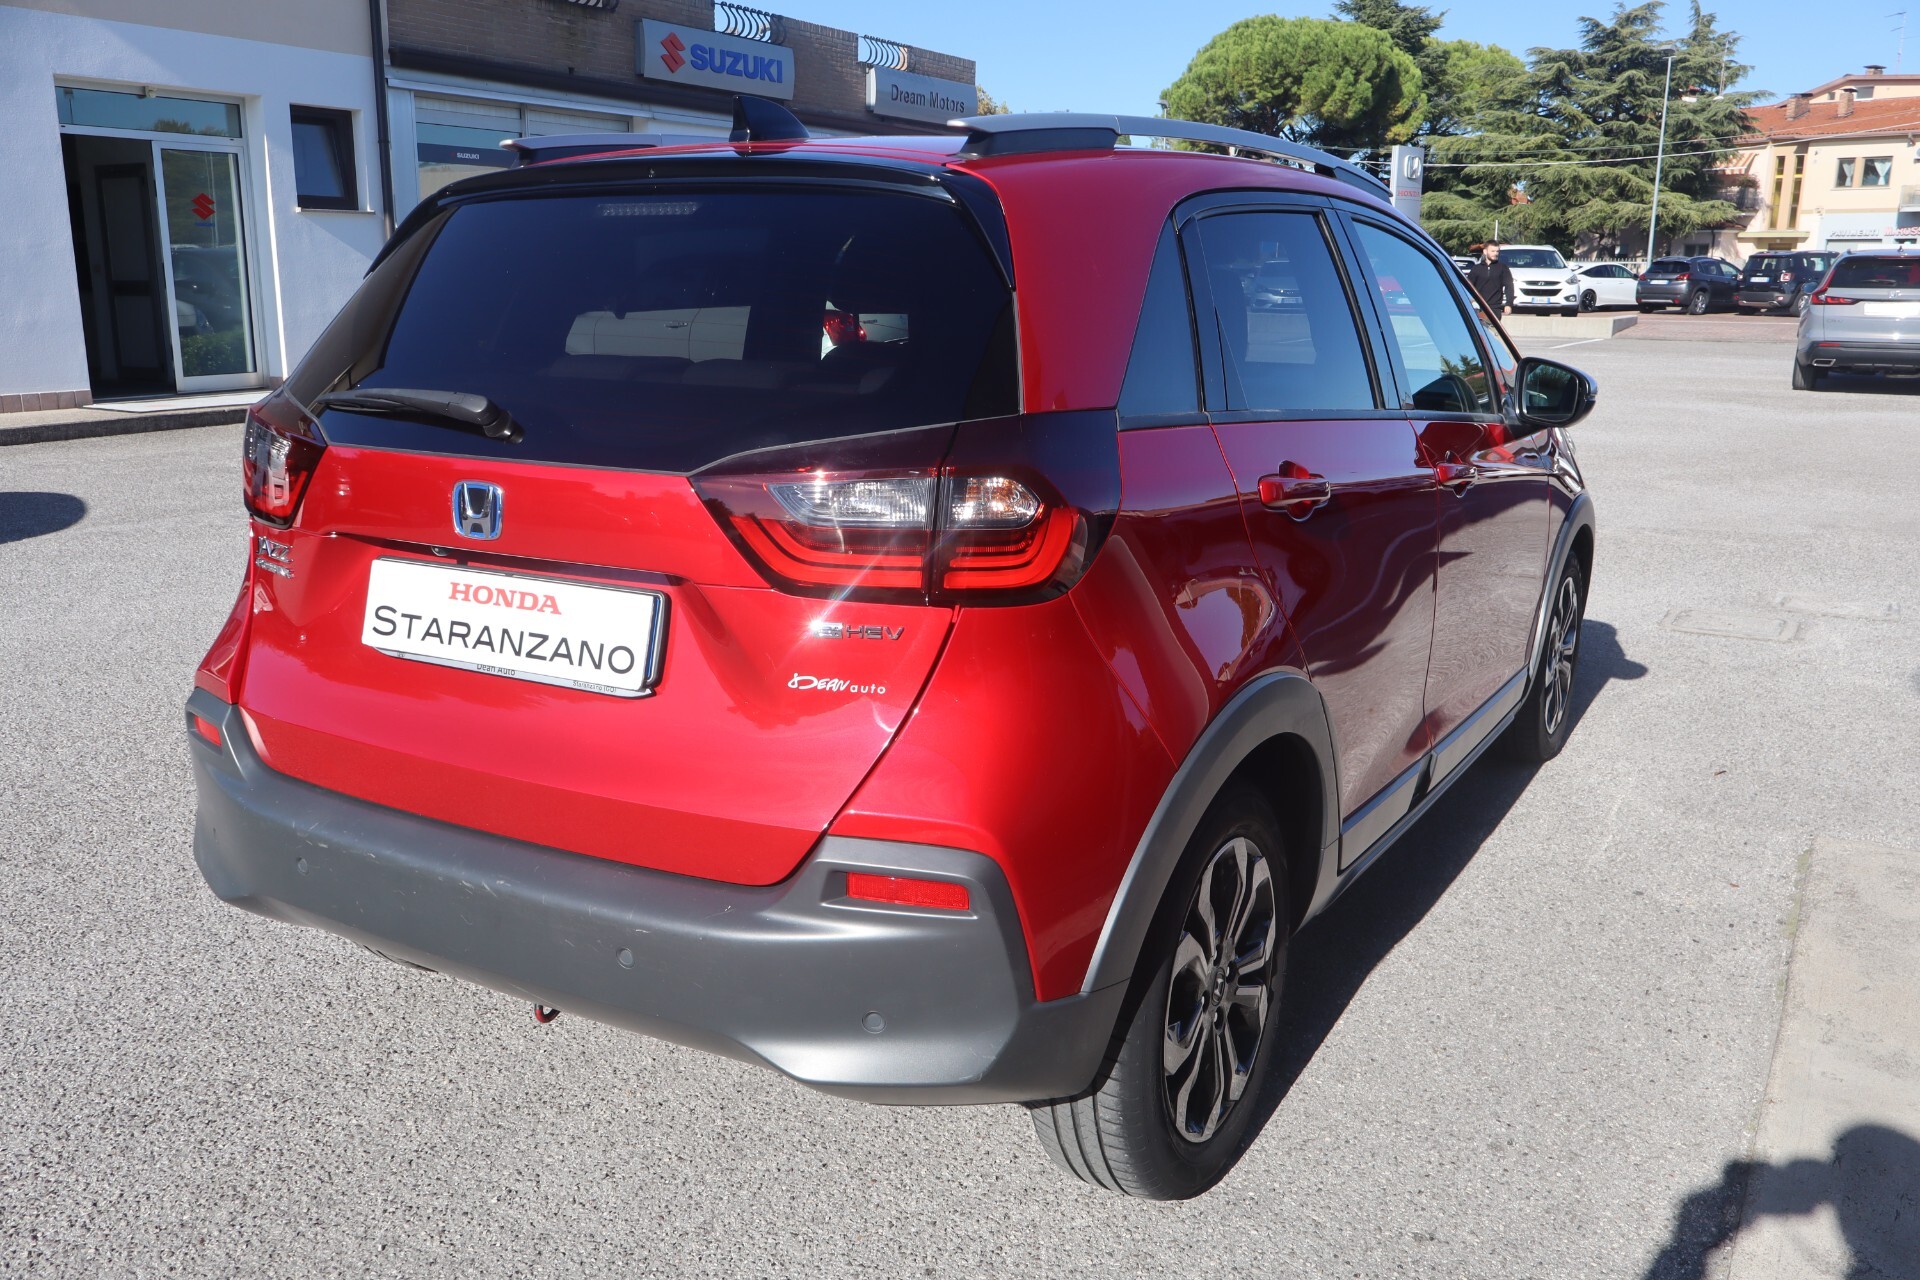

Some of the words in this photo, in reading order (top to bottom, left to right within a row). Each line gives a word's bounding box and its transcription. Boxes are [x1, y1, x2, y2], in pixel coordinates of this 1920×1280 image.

[690, 43, 783, 83] SUZUKI
[891, 84, 925, 106] Dream
[929, 91, 965, 113] Motors
[456, 152, 480, 160] SUZUKI
[448, 581, 563, 616] HONDA
[371, 604, 637, 675] STARANZANO
[477, 664, 495, 672] Dean
[497, 667, 515, 676] Auto
[850, 683, 886, 694] auto
